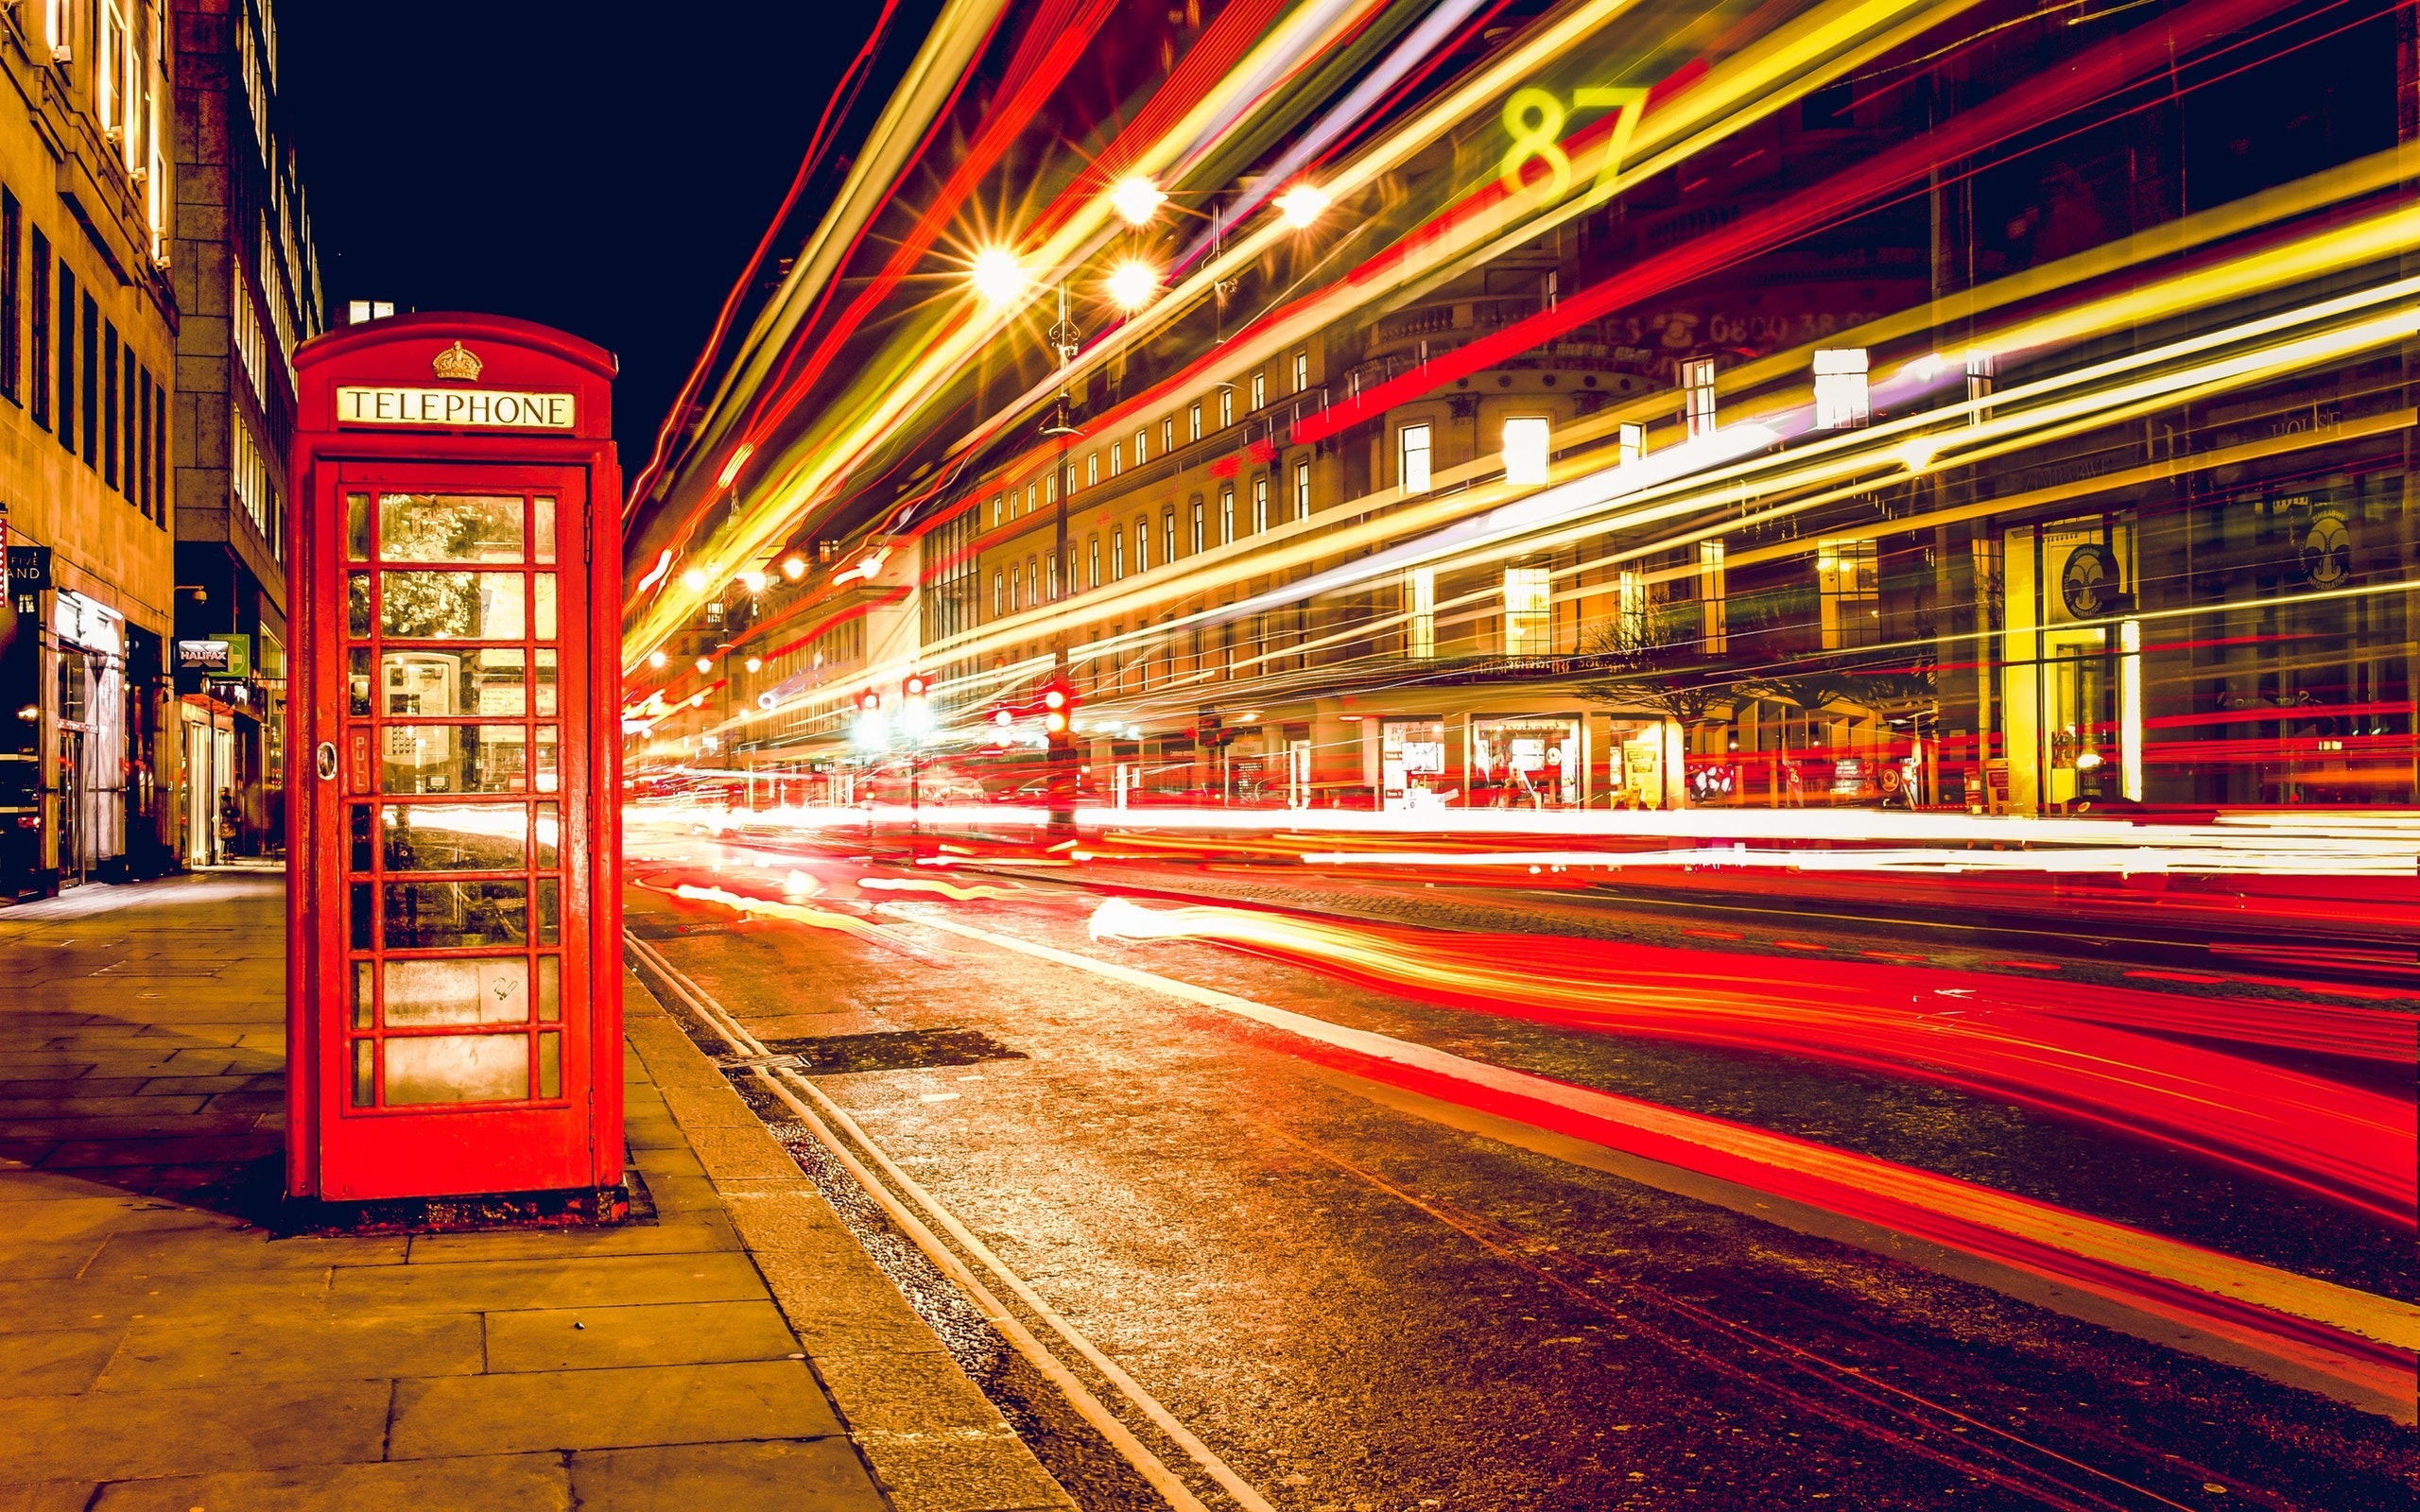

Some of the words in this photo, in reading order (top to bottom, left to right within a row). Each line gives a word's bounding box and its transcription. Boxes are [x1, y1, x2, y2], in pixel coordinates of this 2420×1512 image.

[1499, 88, 1651, 209] 87
[346, 391, 565, 425] TELEPHONE
[2308, 571, 2350, 590] INFORMATION
[181, 651, 227, 660] HALIFAX
[355, 736, 365, 787] PULL
